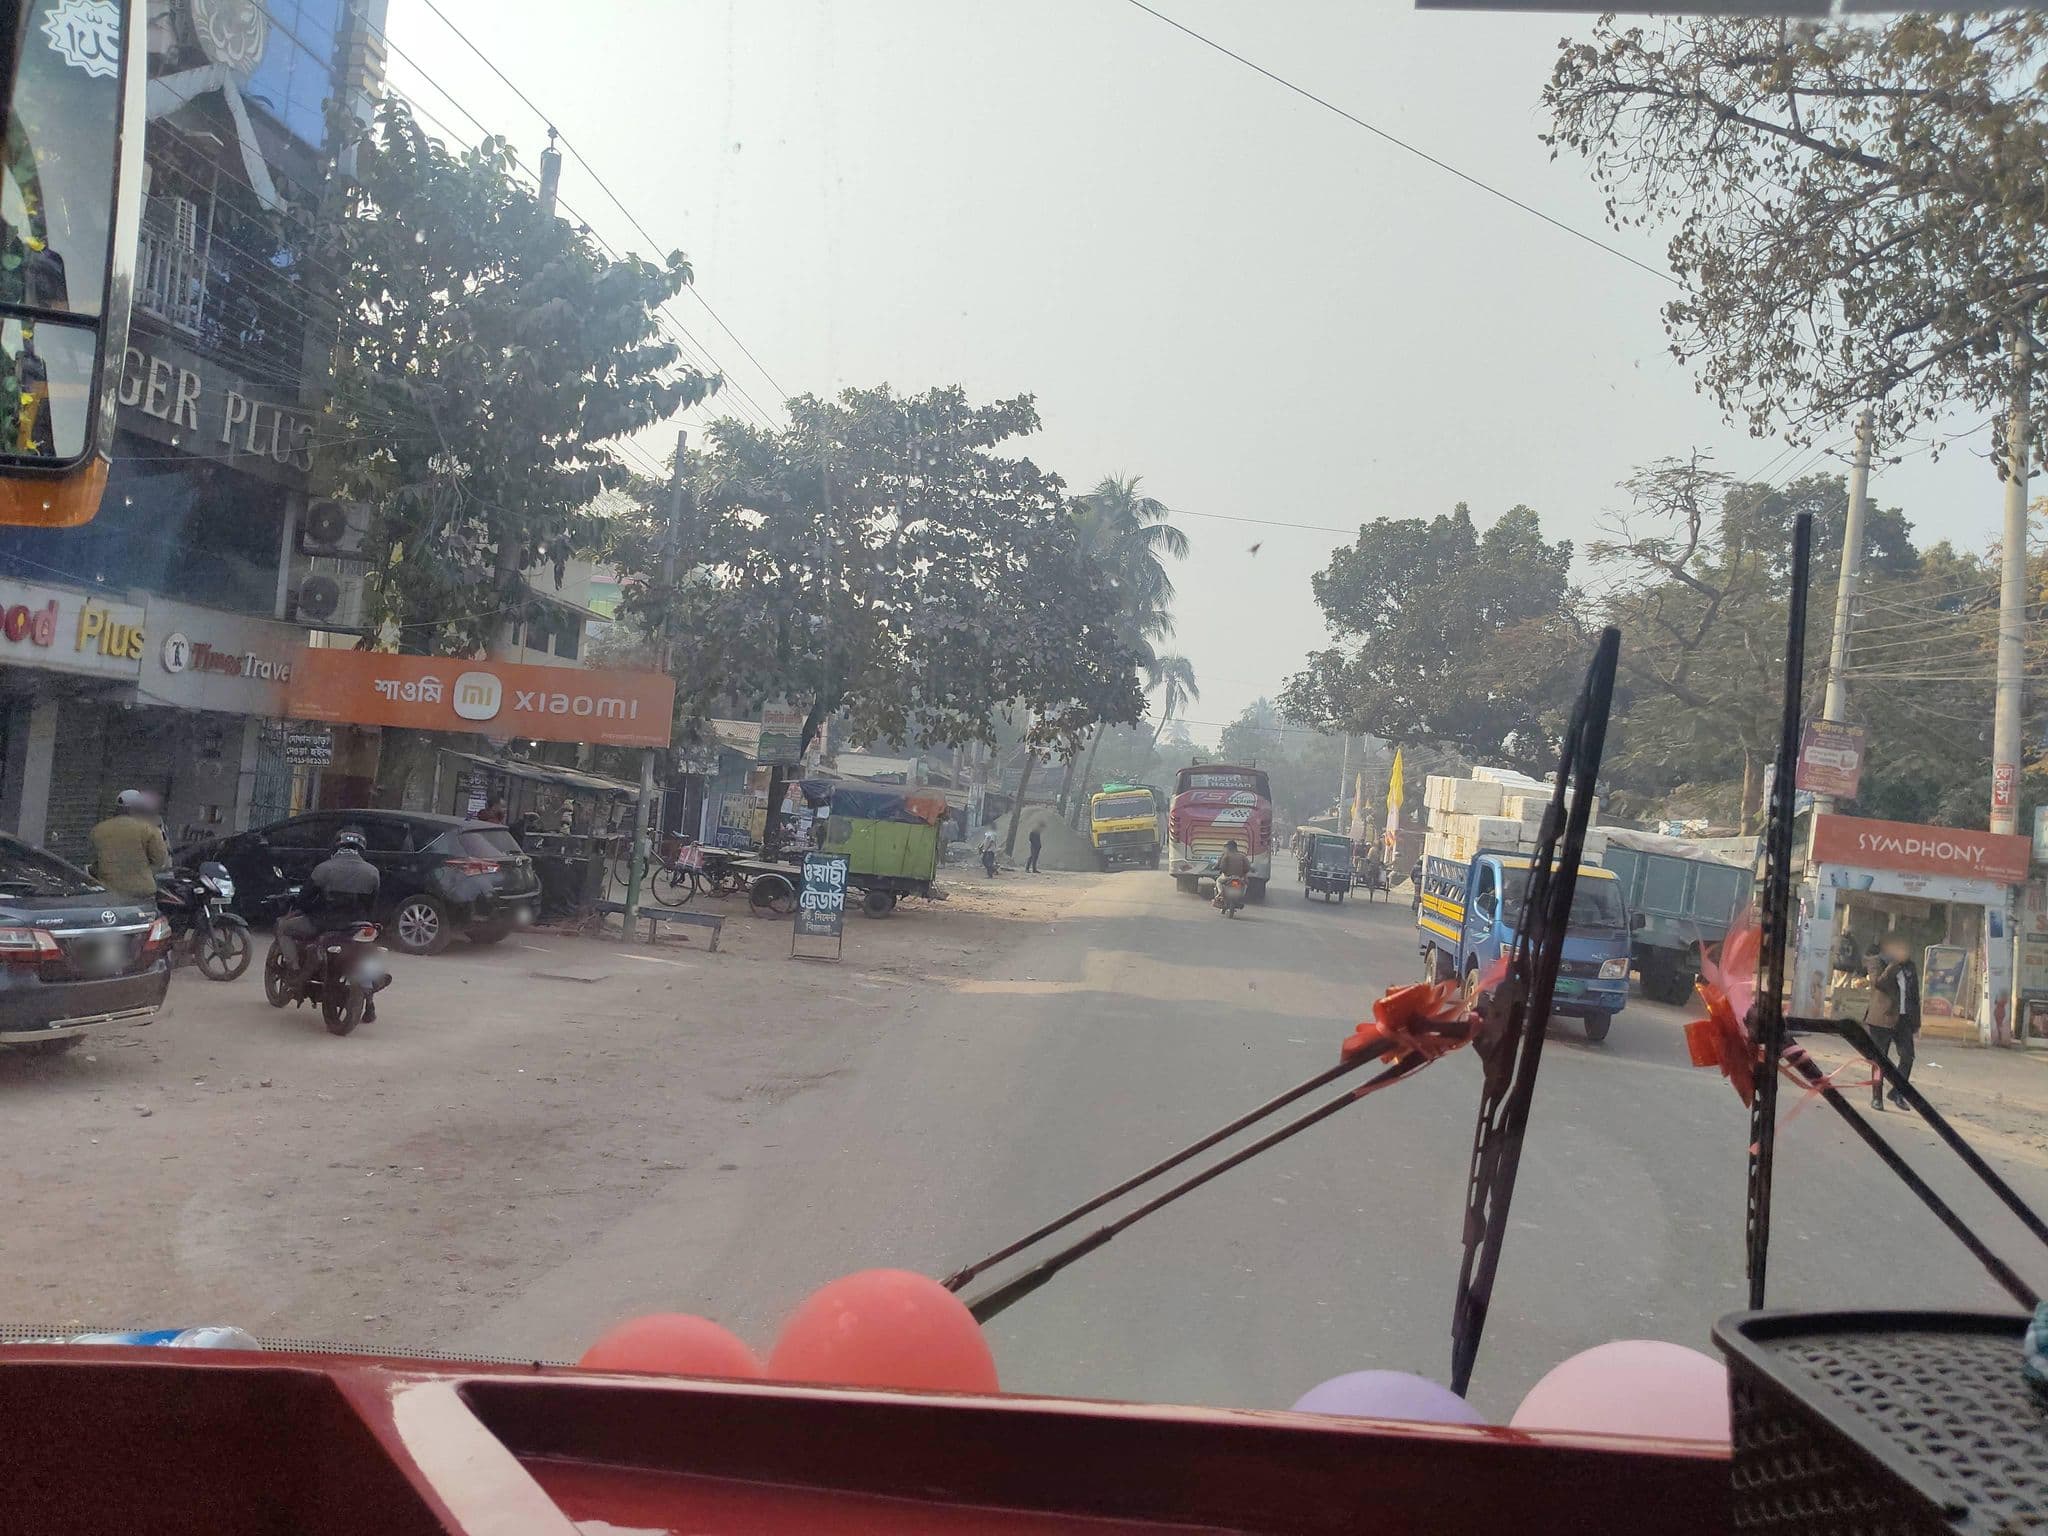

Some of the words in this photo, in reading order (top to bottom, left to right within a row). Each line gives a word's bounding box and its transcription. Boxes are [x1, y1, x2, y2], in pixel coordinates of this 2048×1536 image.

[222, 389, 314, 472] PLUS
[75, 600, 144, 660] Plus
[374, 676, 443, 704] শাওমি
[514, 690, 638, 720] xiaomi
[1858, 833, 1985, 863] SYMPHONY
